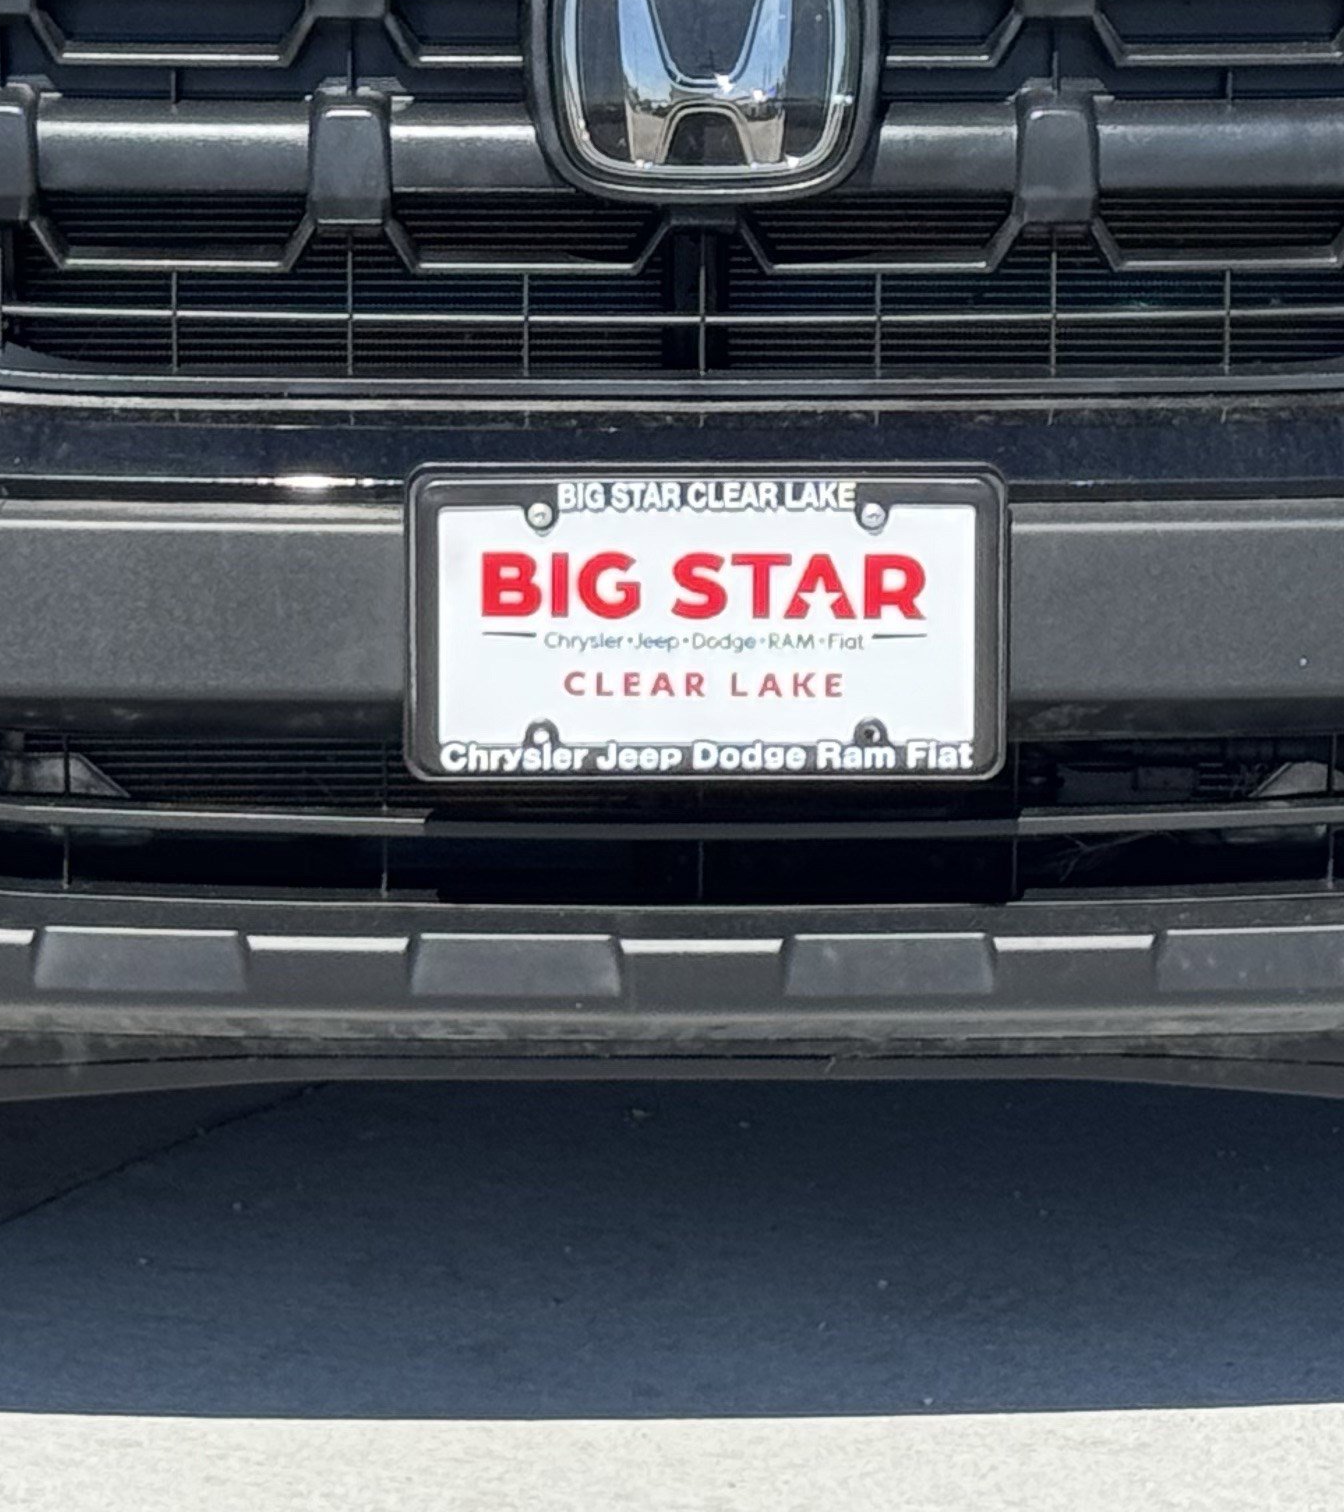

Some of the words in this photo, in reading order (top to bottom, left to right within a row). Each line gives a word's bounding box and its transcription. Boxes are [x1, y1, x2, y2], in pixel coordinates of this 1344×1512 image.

[557, 482, 605, 510] BIG
[610, 482, 682, 510] STAR
[686, 482, 779, 510] CLEAR
[784, 482, 857, 509] LAKE
[481, 551, 641, 619] BIG
[670, 551, 927, 620] STAR
[564, 671, 705, 697] CLEAR
[730, 672, 843, 697] LAKE
[439, 742, 589, 772] Chrysler
[596, 742, 683, 771] Jeep
[692, 740, 807, 770] Dodge
[816, 741, 896, 769] Ram
[906, 741, 974, 769] Fiat
